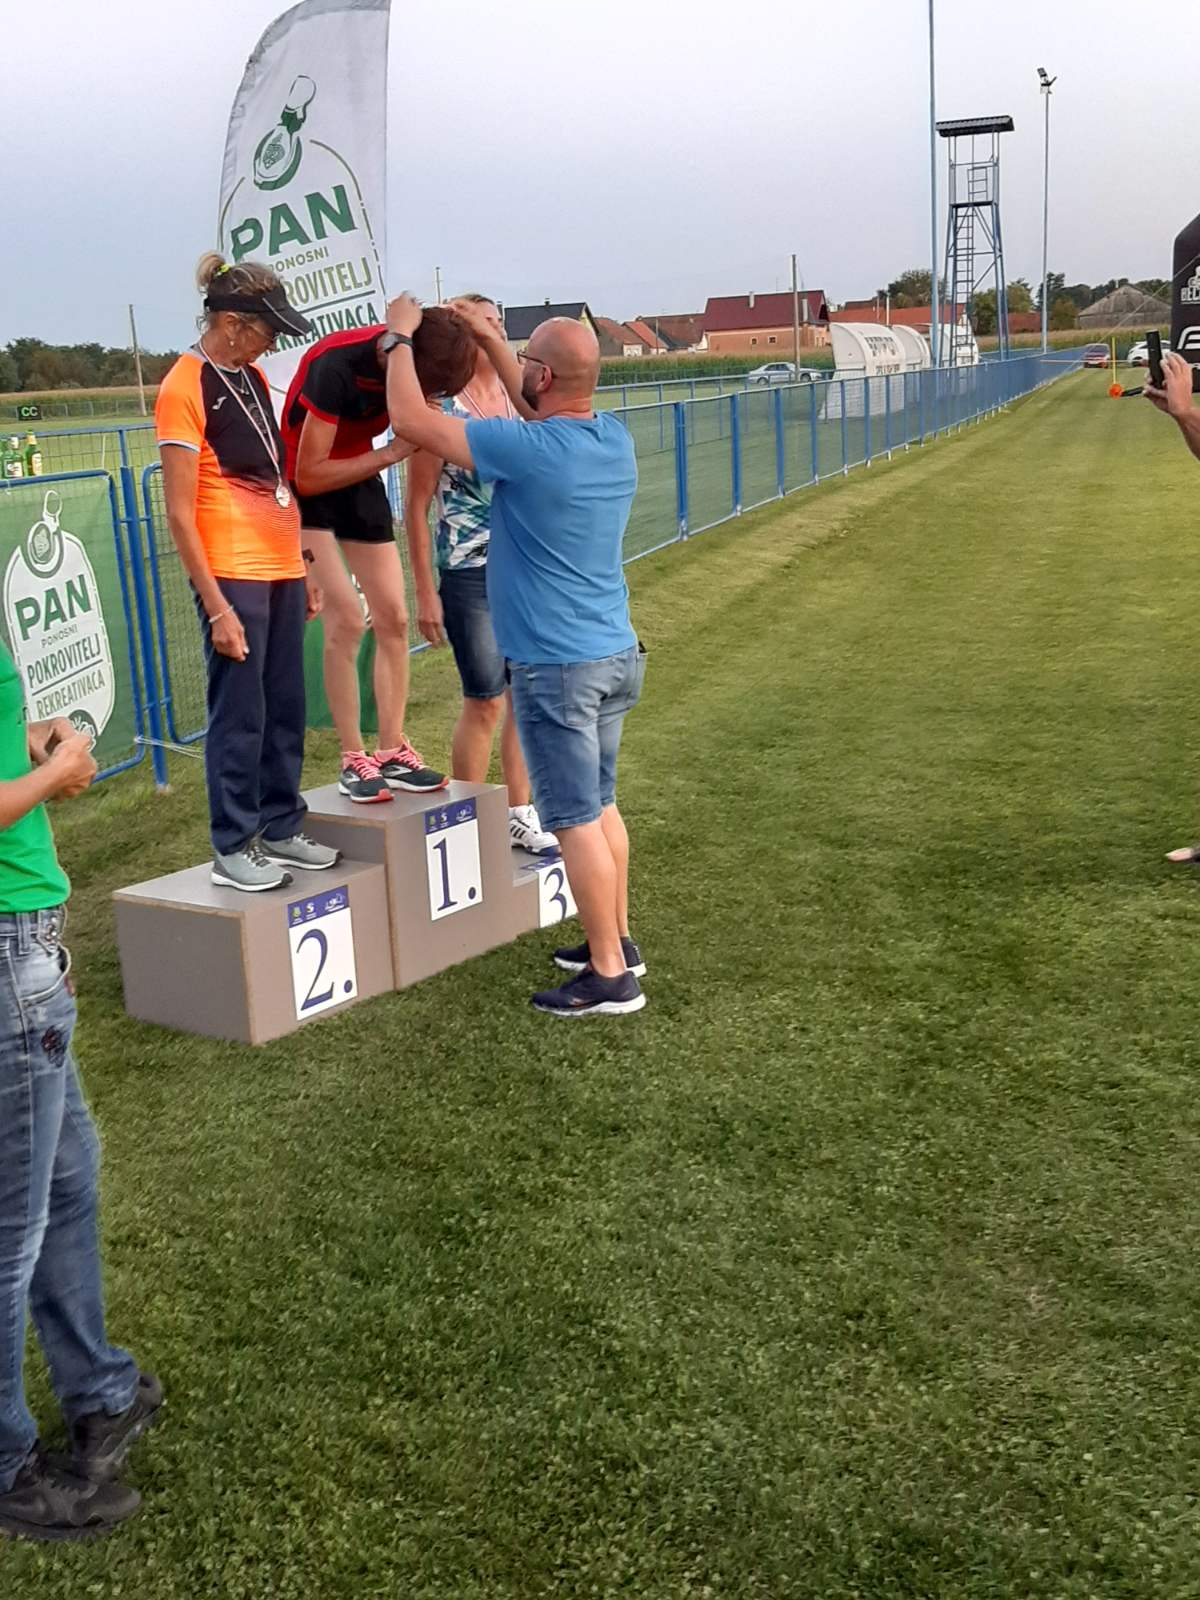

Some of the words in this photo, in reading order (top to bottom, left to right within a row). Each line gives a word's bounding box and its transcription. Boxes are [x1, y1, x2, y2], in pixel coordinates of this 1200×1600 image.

[231, 185, 357, 263] PAN
[284, 257, 373, 307] ROVITELJ
[14, 574, 92, 642] PAN
[41, 623, 78, 648] PONOSNI
[27, 633, 101, 689] POKROVITELJ
[36, 669, 105, 720] REKREATIVACA
[433, 837, 477, 912] 1.
[296, 928, 353, 1011] 2.
